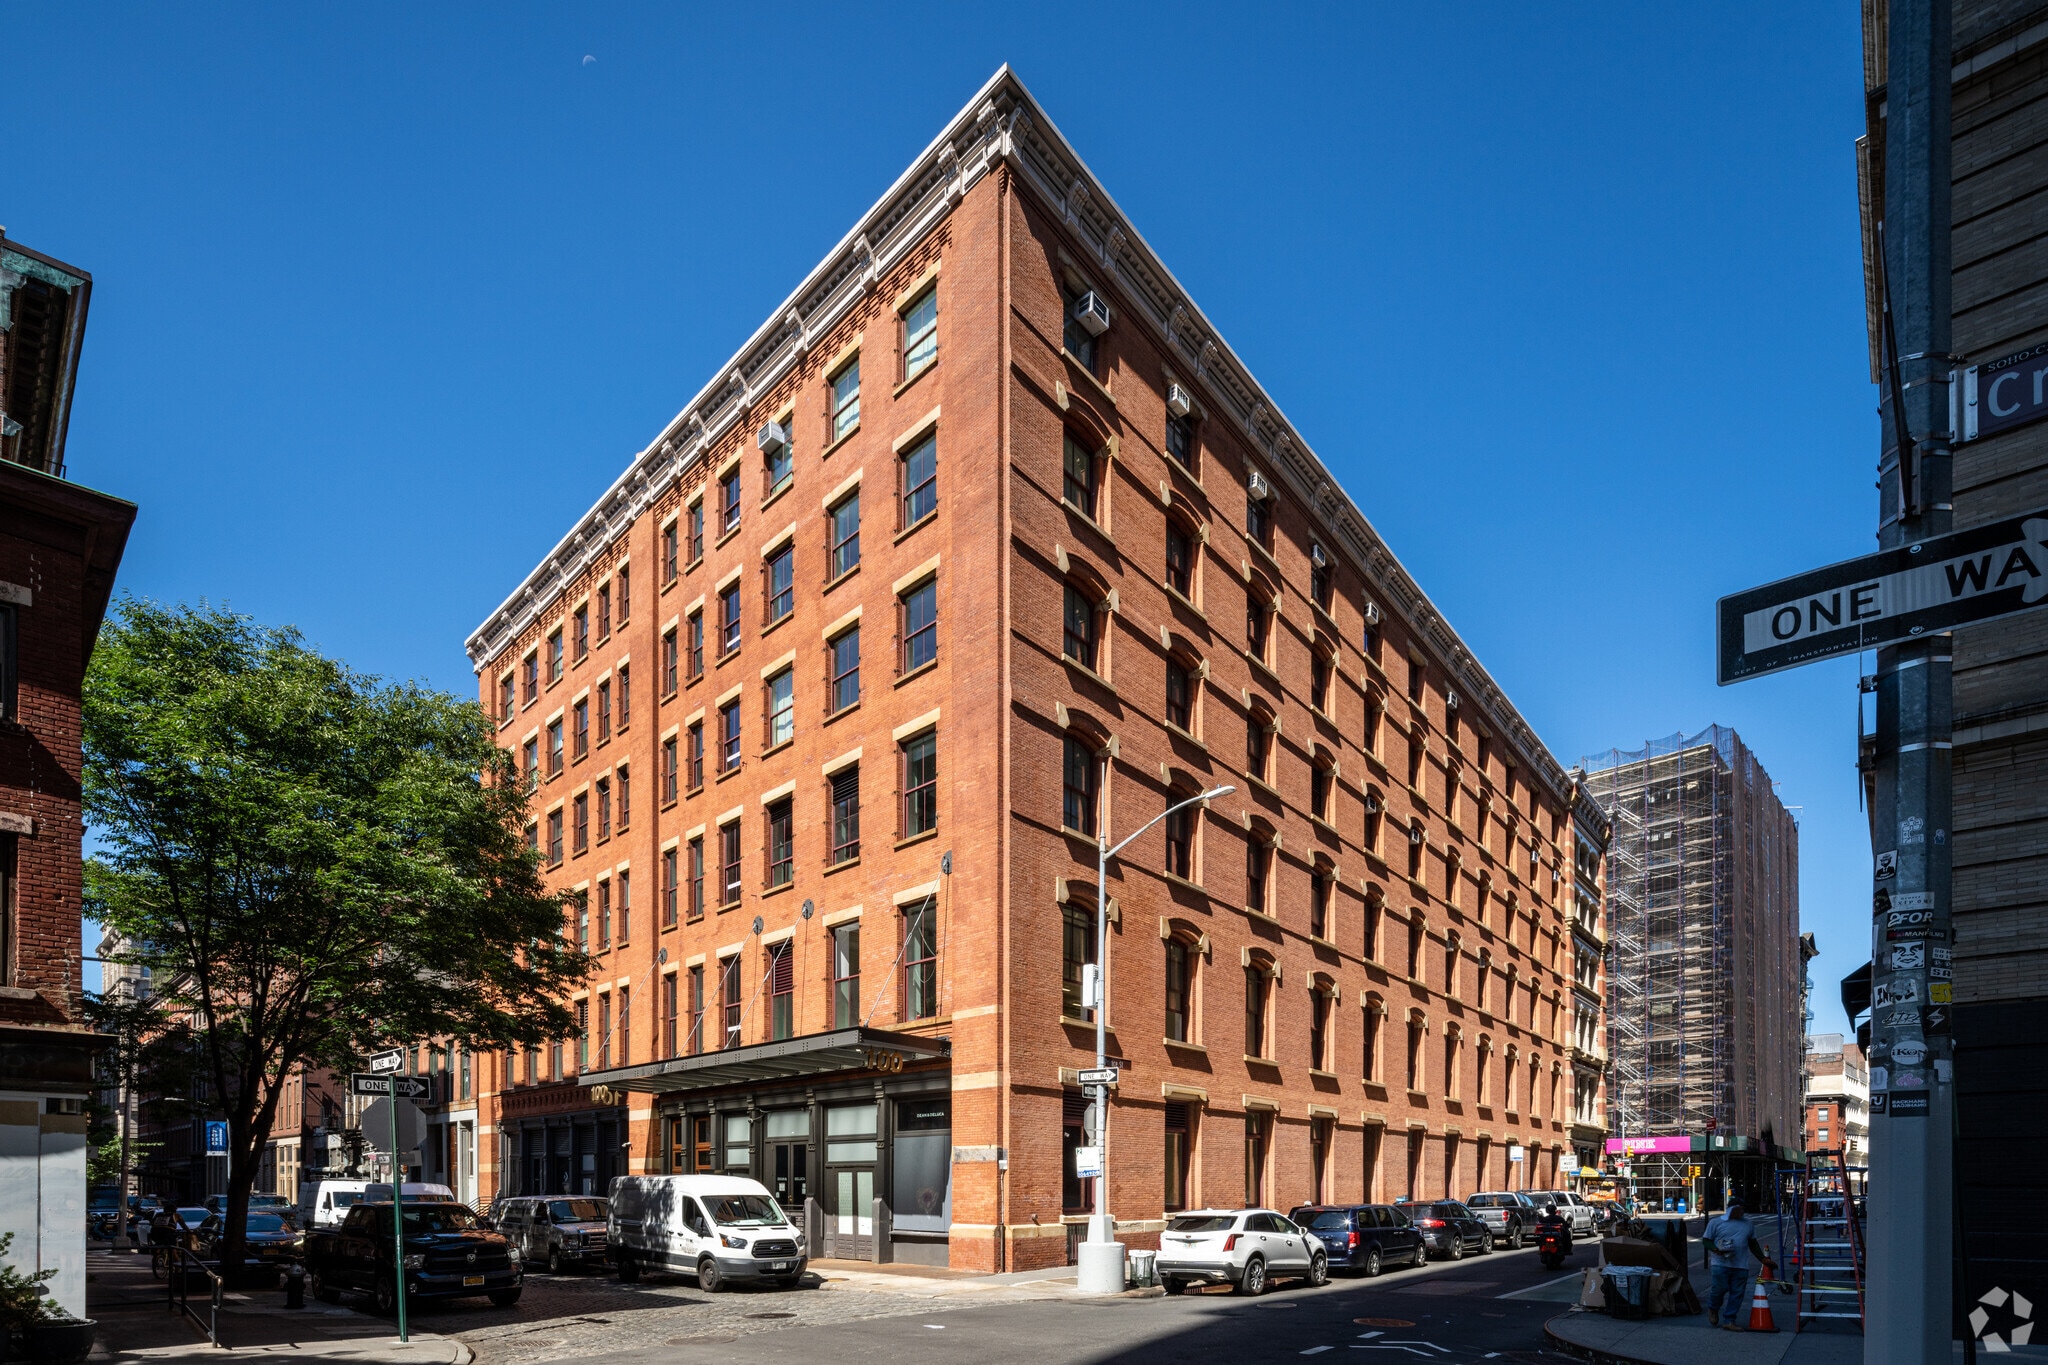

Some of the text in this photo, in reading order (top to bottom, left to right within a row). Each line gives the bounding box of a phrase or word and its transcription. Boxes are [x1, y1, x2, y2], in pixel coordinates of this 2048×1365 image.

[1988, 344, 2048, 372] SOHO-C
[1771, 538, 2048, 640] ONE WA
[1734, 665, 1757, 676] DEPT
[1788, 635, 1878, 662] TRANSPORTATON
[1888, 911, 1933, 928] 2FOR
[375, 1057, 398, 1069] ONE WAY
[867, 1048, 903, 1073] 100
[365, 1081, 419, 1092] ONE WAY
[1624, 1138, 1656, 1150] PINK
